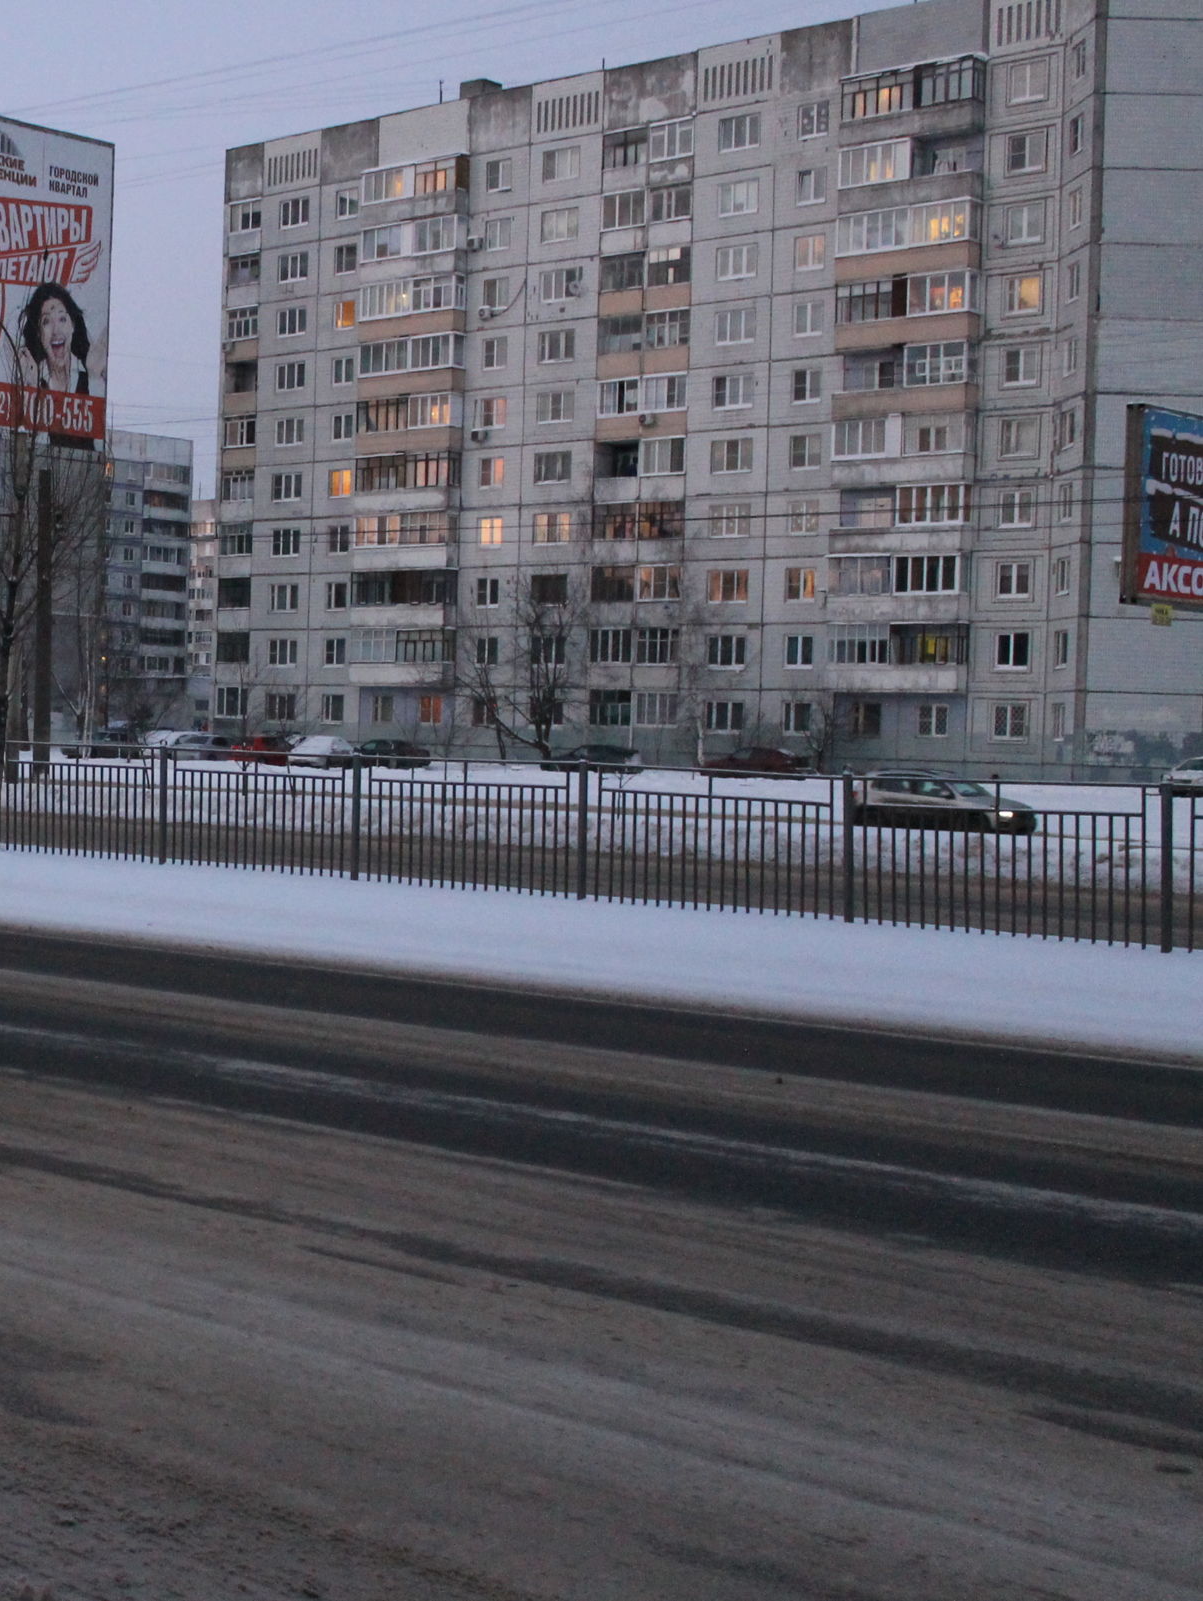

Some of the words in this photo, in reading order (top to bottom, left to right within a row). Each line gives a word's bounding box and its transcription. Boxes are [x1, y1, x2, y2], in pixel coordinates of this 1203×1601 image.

[49, 165, 99, 187] ГОРОДСКОЙ
[49, 180, 88, 199] КВАРТАЛ
[1169, 501, 1180, 538] А
